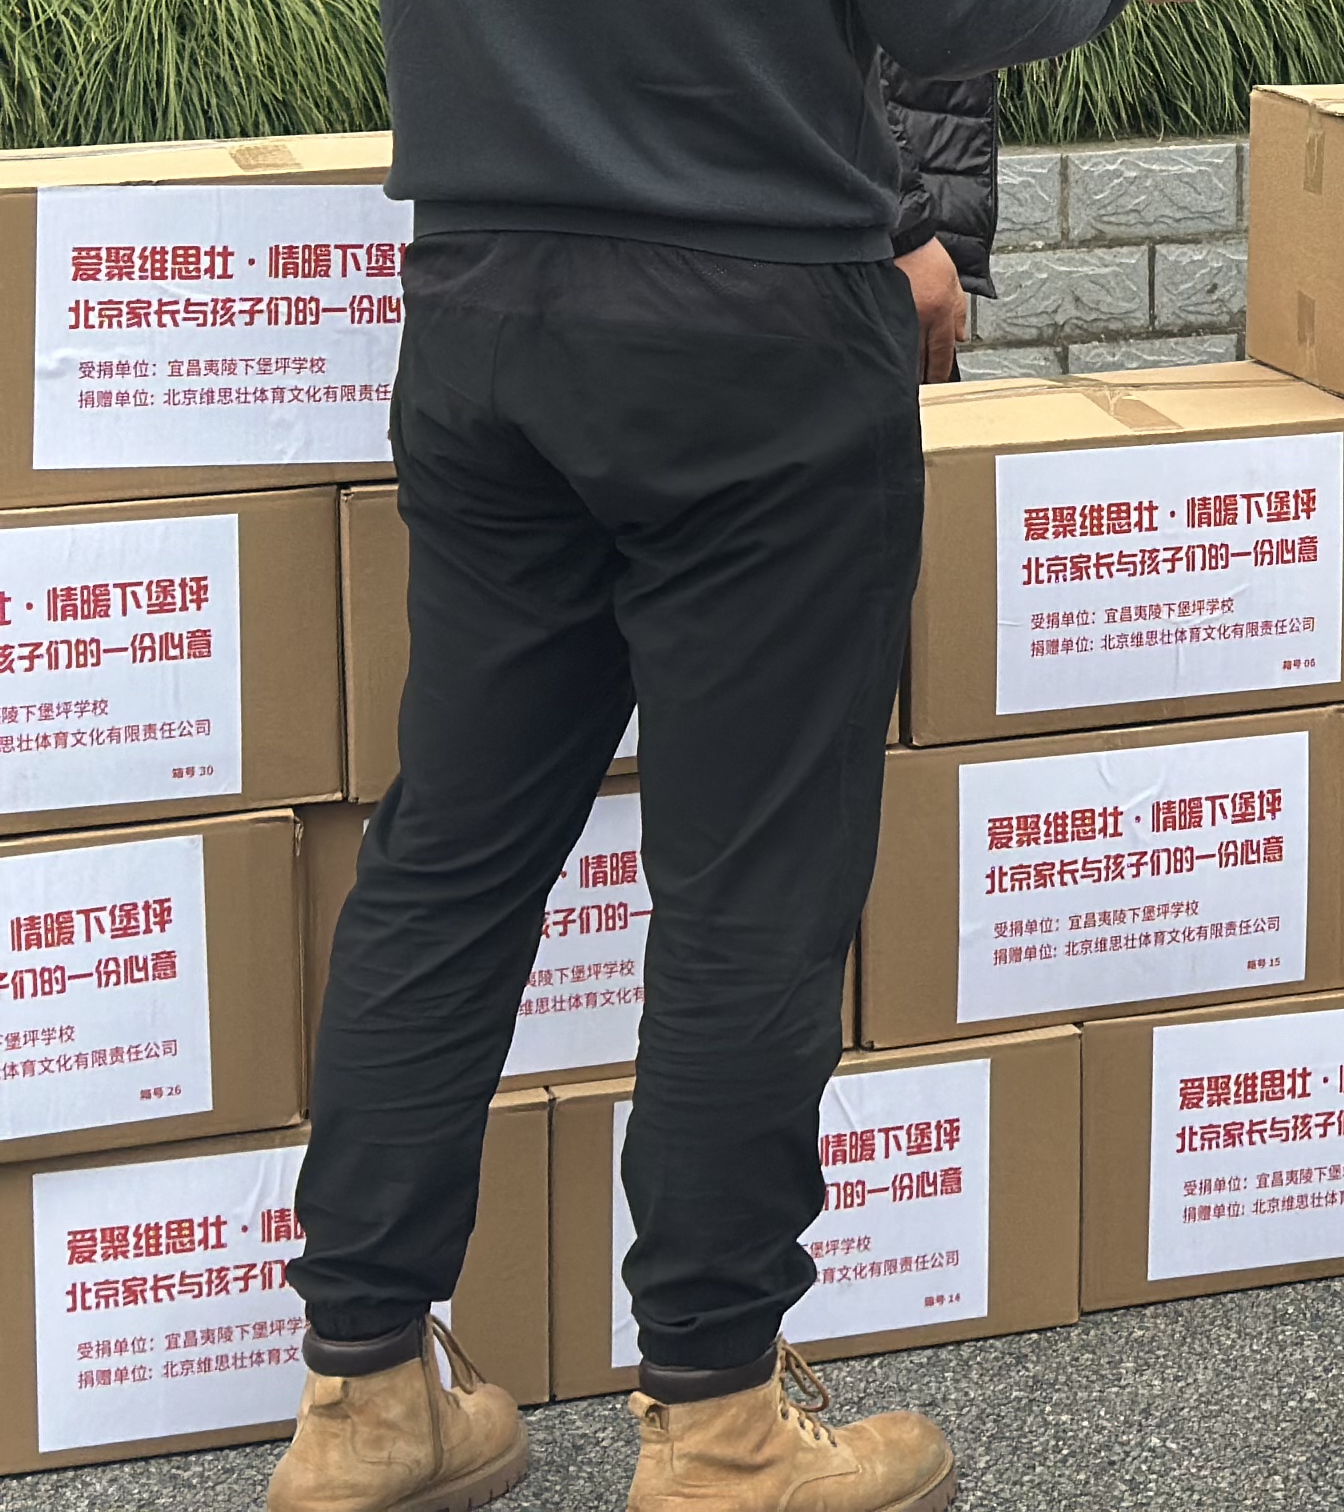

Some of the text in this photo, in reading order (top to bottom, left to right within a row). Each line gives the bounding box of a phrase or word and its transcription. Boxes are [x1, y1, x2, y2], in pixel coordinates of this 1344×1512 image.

[71, 243, 407, 281] 爱聚维思壮·情暖下堡
[1023, 488, 1317, 542] 爱聚维思壮·情暖下堡坪
[1022, 536, 1318, 586] 北京家长与孩子们的一份心意
[987, 788, 1282, 851] 爱聚维思壮·情暖下堡坪
[985, 836, 1284, 894] 北京家长与孩子们的一份心意
[10, 897, 172, 952] 情暖下堡坪
[0, 1024, 75, 1051] 堡坪学校
[0, 1039, 178, 1081] 体育文化有限责任公司
[78, 1317, 310, 1360] 受捐单位：宜昌夷陵下堡坪学
